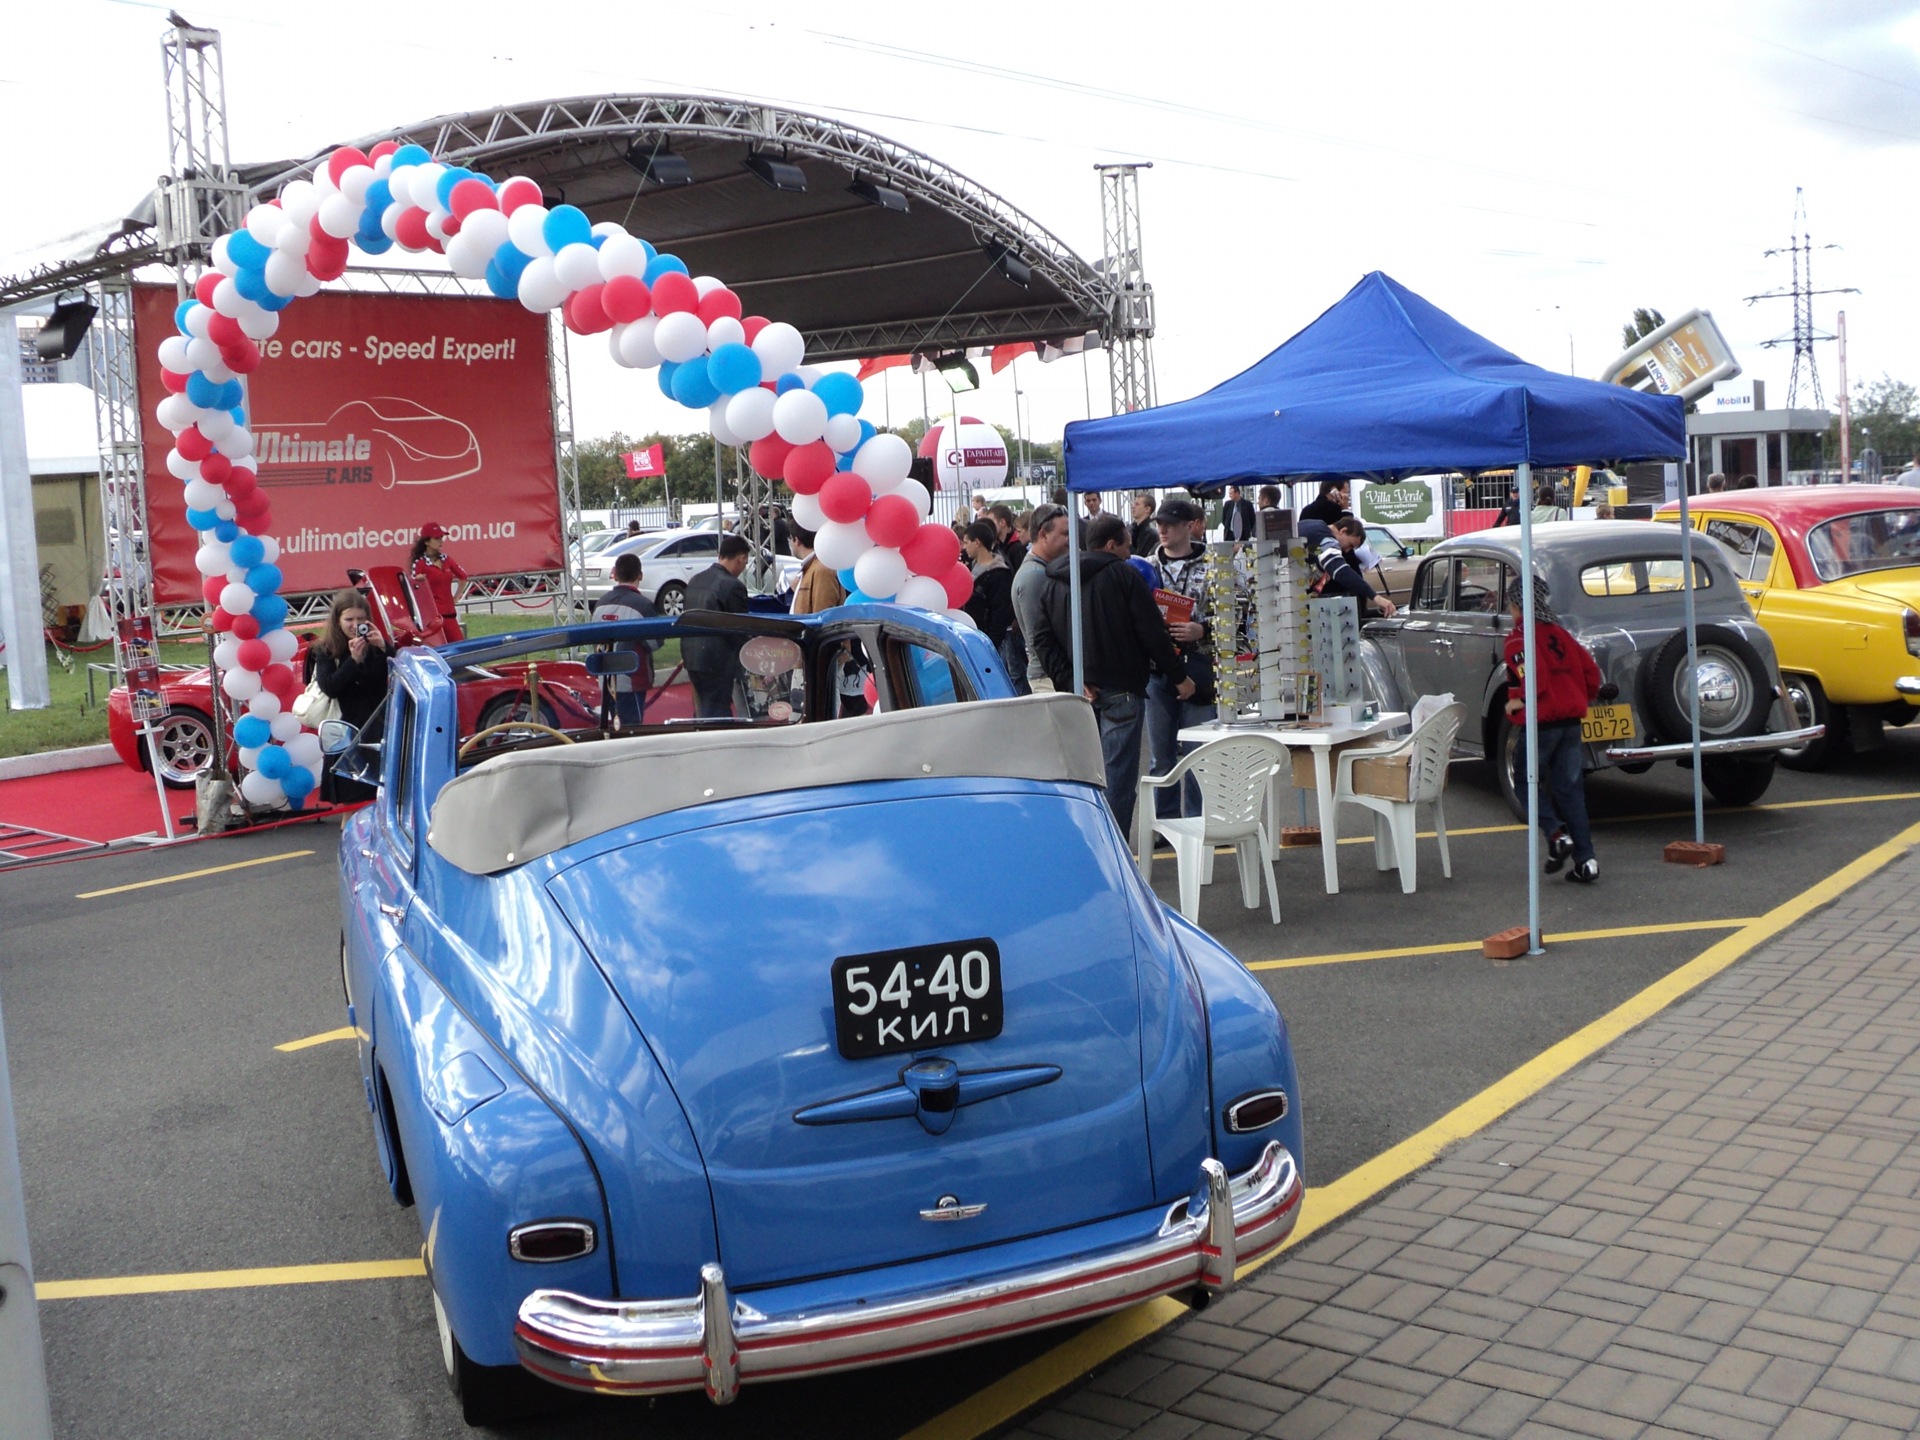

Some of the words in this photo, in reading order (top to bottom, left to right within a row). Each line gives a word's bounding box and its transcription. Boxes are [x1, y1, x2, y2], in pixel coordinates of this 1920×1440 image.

[290, 340, 342, 358] cars
[364, 335, 436, 366] Speed
[442, 337, 517, 366] Expert!
[1717, 397, 1742, 405] Mobil
[250, 432, 371, 463] Ultimate
[325, 466, 373, 484] CARS
[1365, 490, 1391, 503] Villa
[1393, 489, 1424, 501] Verde
[1593, 708, 1615, 719] ЩЮ
[1582, 718, 1631, 739] 00-72
[846, 950, 990, 1015] 54-40
[877, 1006, 970, 1046] КИЛ
